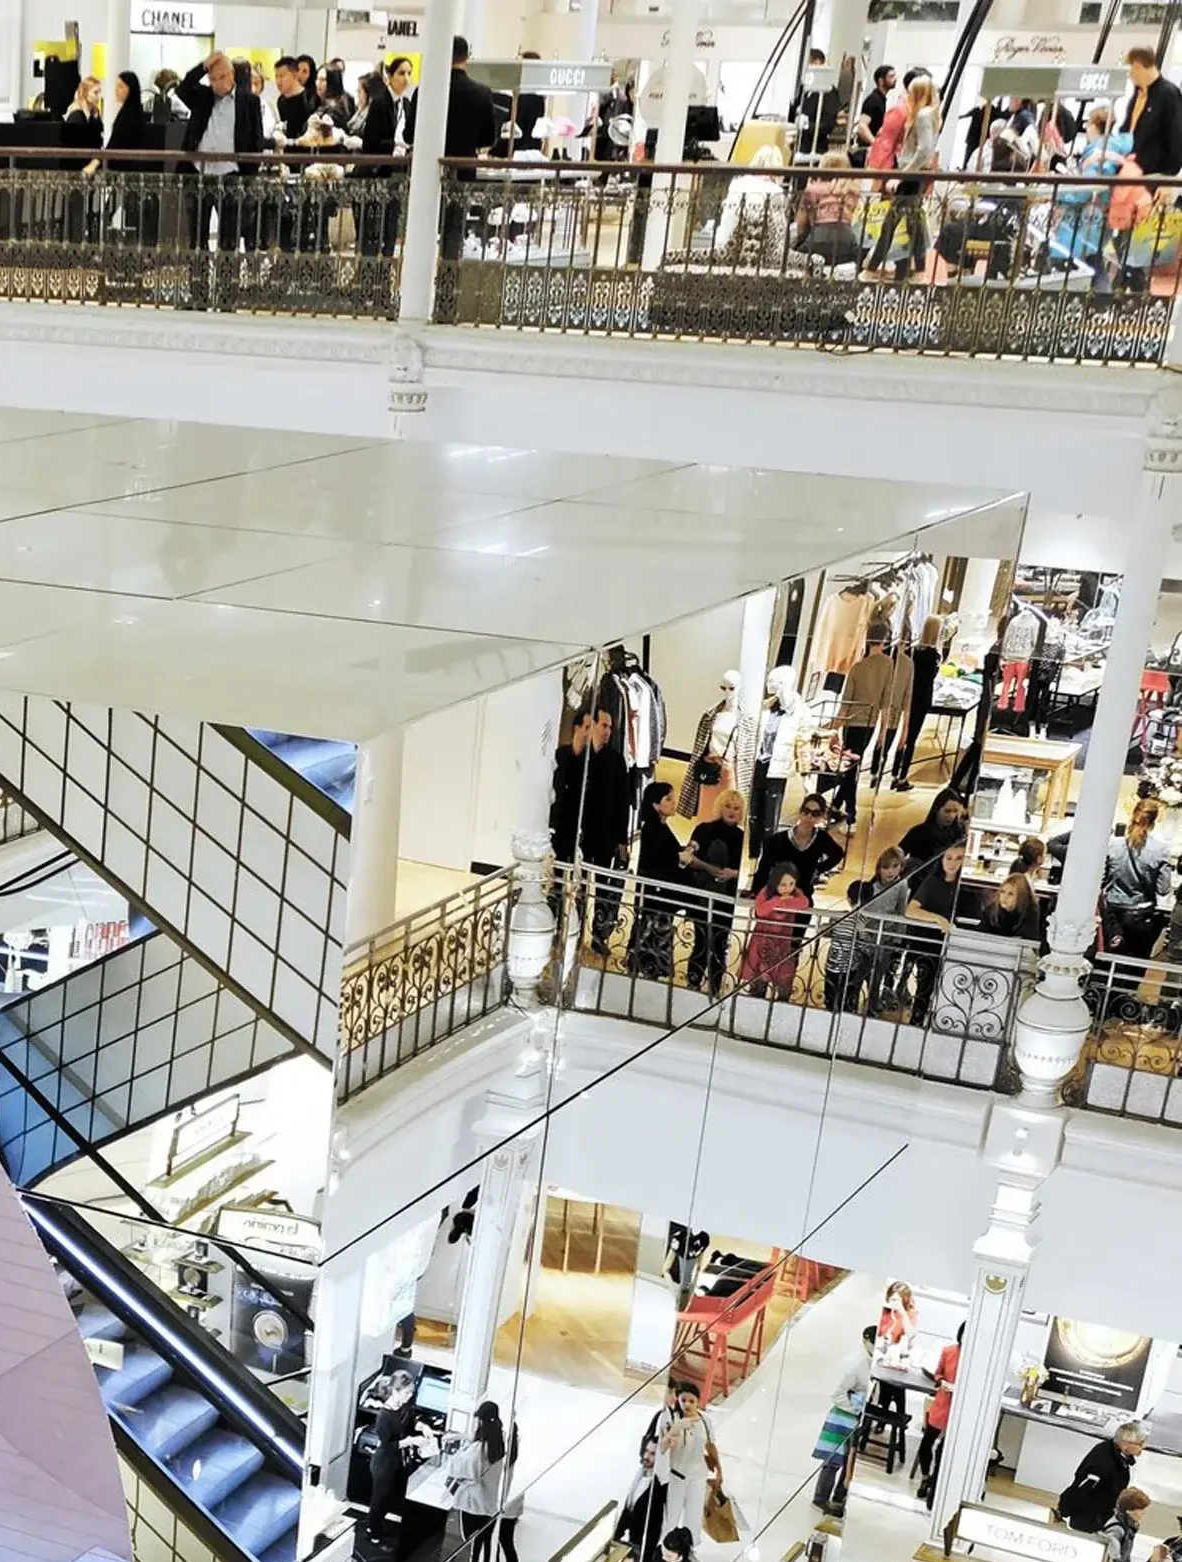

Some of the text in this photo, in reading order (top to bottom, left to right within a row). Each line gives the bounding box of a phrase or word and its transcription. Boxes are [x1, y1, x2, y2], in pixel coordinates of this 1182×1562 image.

[141, 9, 195, 29] CHANEL
[549, 67, 586, 86] GUCCI
[986, 1523, 1078, 1559] TOM FORD
